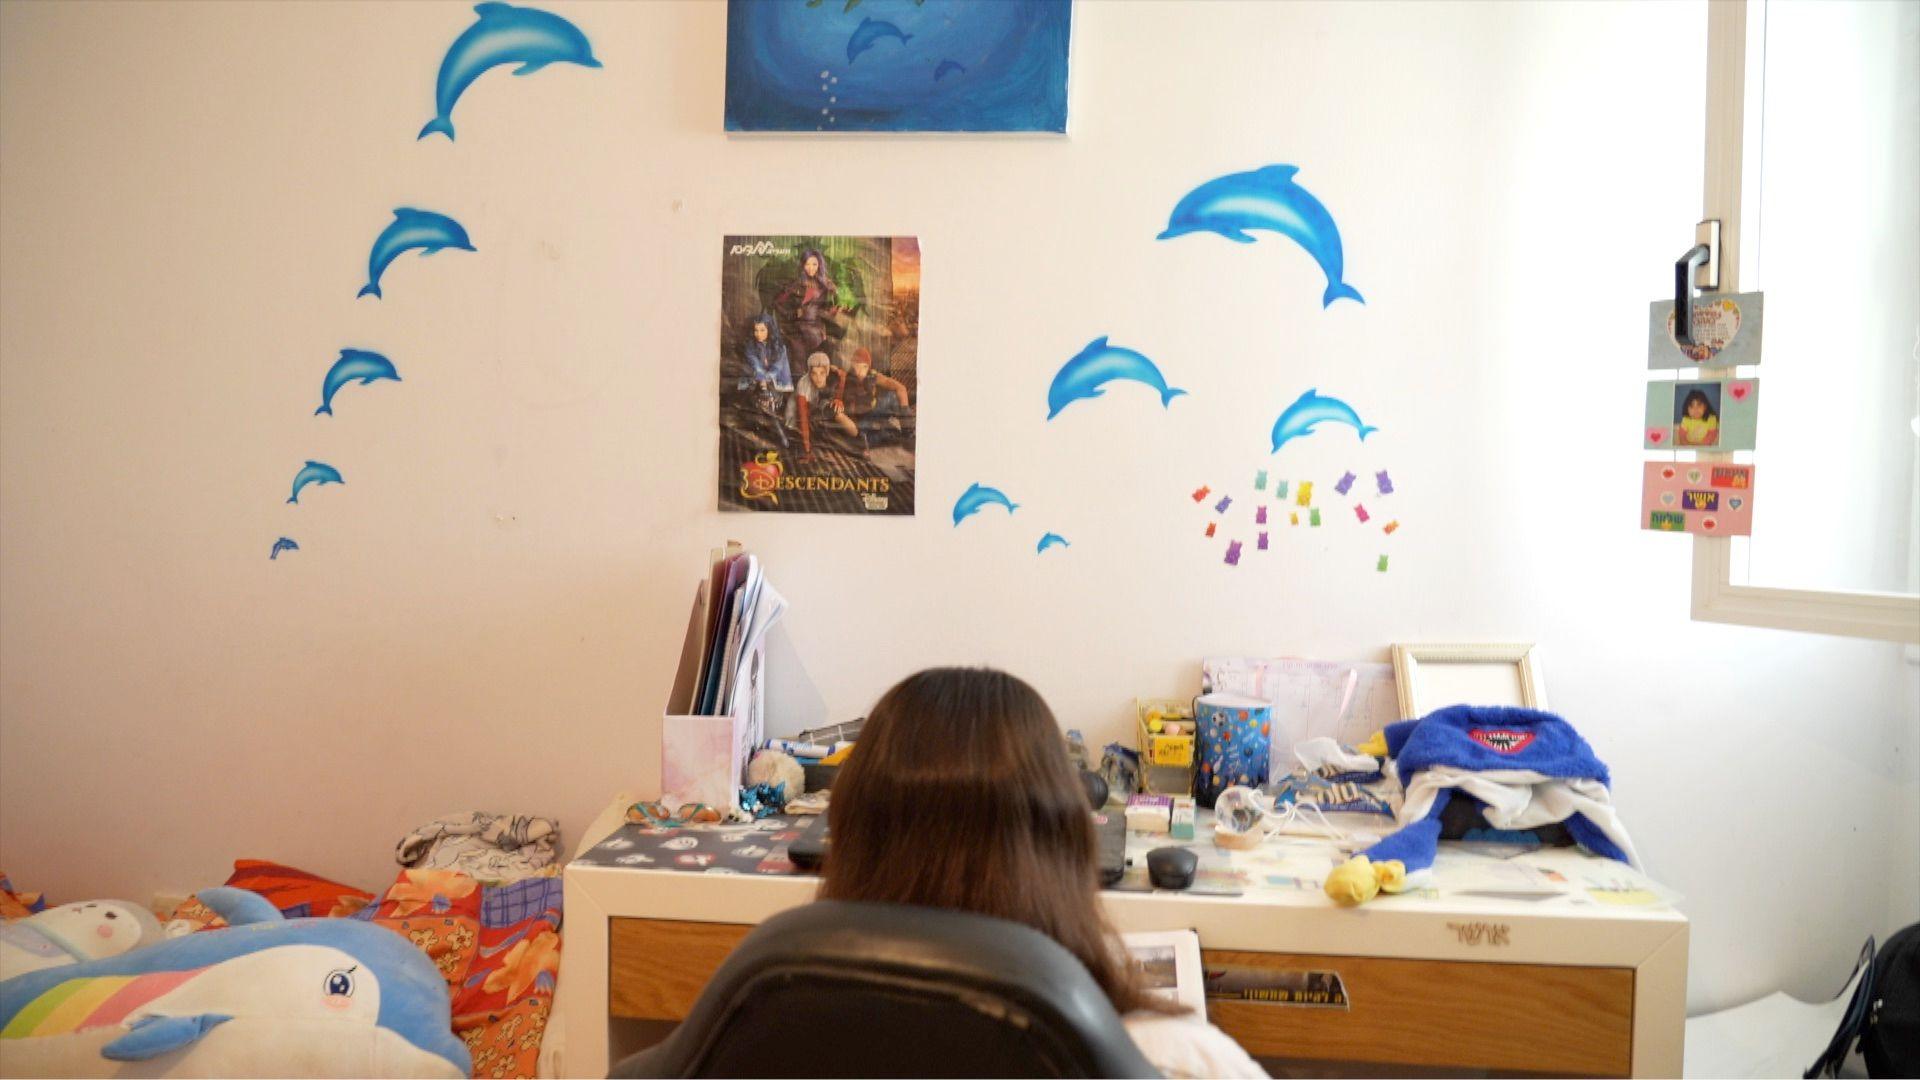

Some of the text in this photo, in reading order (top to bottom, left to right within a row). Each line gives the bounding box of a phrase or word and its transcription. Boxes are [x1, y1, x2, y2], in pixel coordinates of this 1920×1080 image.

[752, 472, 890, 493] DESCENDANTS
[1687, 492, 1716, 506] אושר
[1446, 921, 1511, 946] אושר
